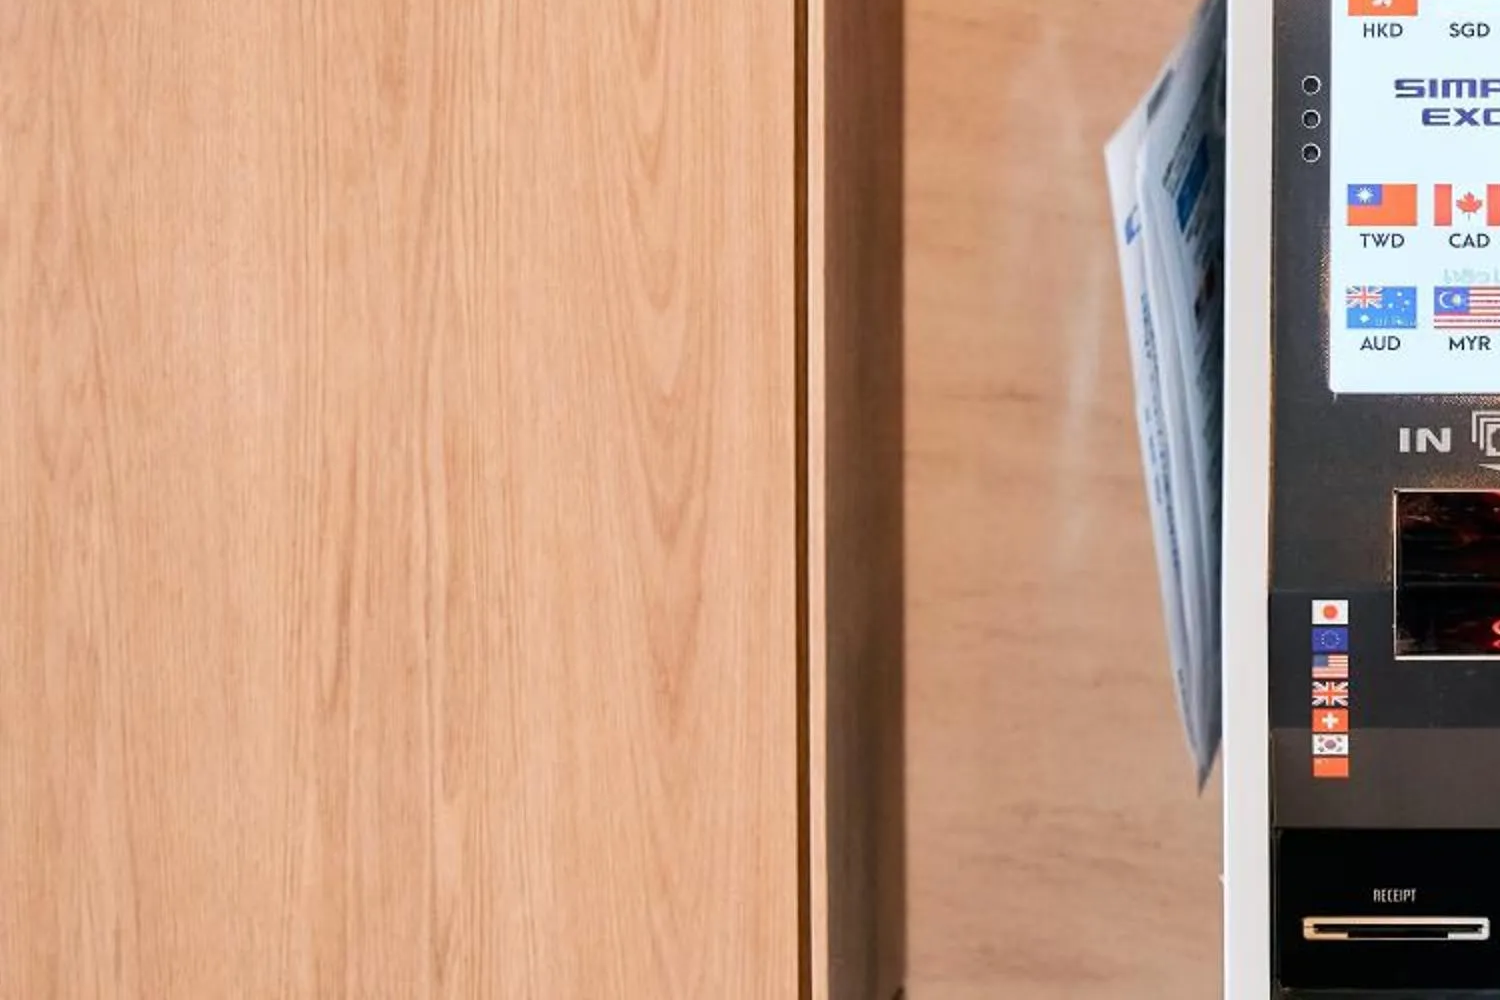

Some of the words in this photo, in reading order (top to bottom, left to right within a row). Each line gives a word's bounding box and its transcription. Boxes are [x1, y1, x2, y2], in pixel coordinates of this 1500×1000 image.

[1363, 23, 1403, 38] HKD
[1449, 23, 1490, 38] SGD
[1360, 233, 1404, 248] TWD
[1449, 233, 1490, 249] CAD
[1360, 336, 1400, 351] AUD
[1449, 336, 1491, 351] MYR
[1400, 427, 1451, 453] IN
[1373, 888, 1416, 903] RECEIPT
